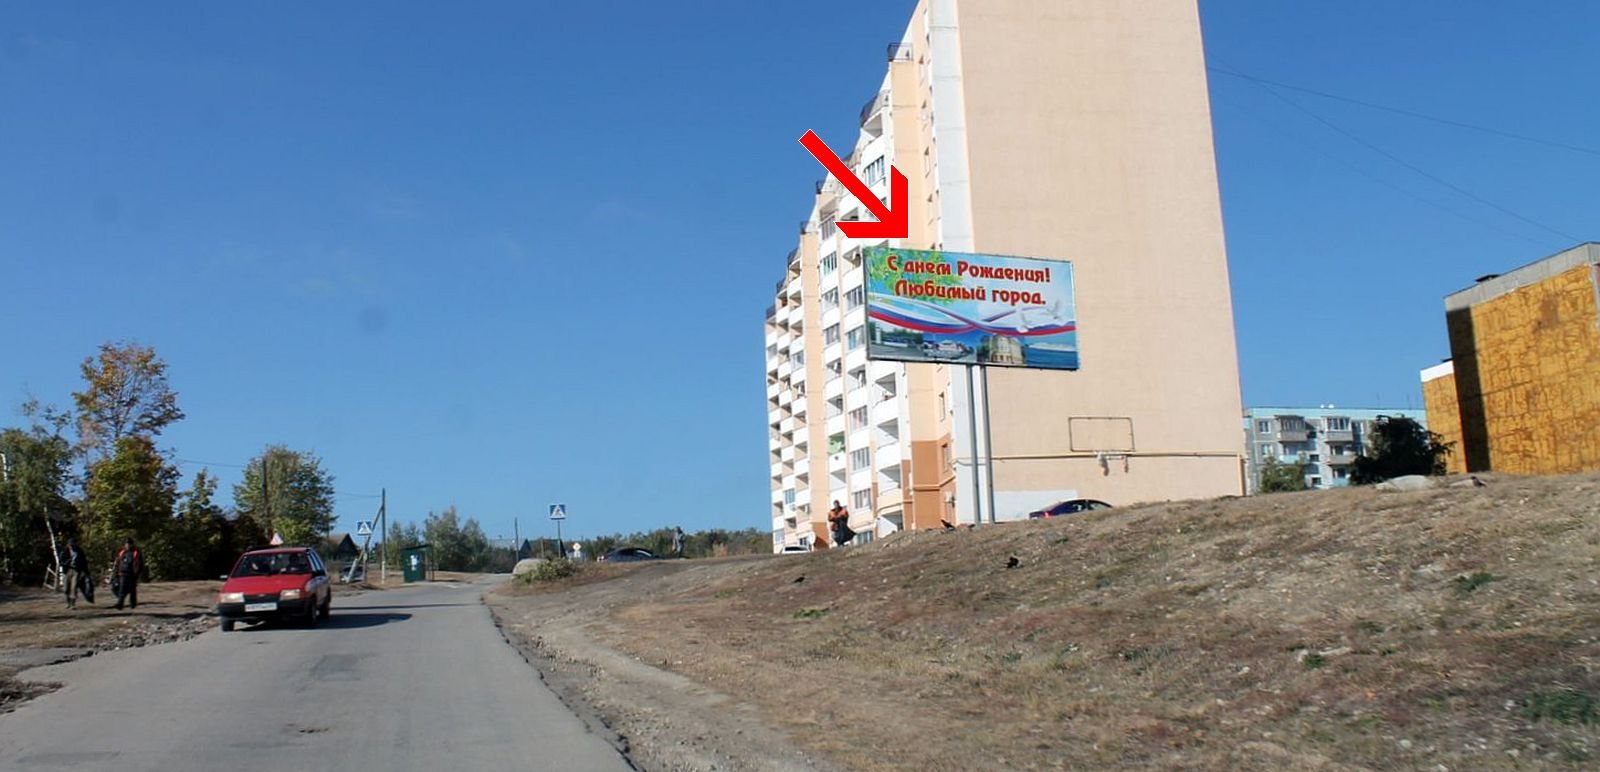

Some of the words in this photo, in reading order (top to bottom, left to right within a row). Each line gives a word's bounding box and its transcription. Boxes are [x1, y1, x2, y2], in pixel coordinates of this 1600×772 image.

[887, 256, 898, 271] С
[904, 261, 952, 275] днем
[957, 261, 1050, 283] Рождения!
[895, 280, 986, 301] Любимый
[992, 288, 1046, 305] город.
